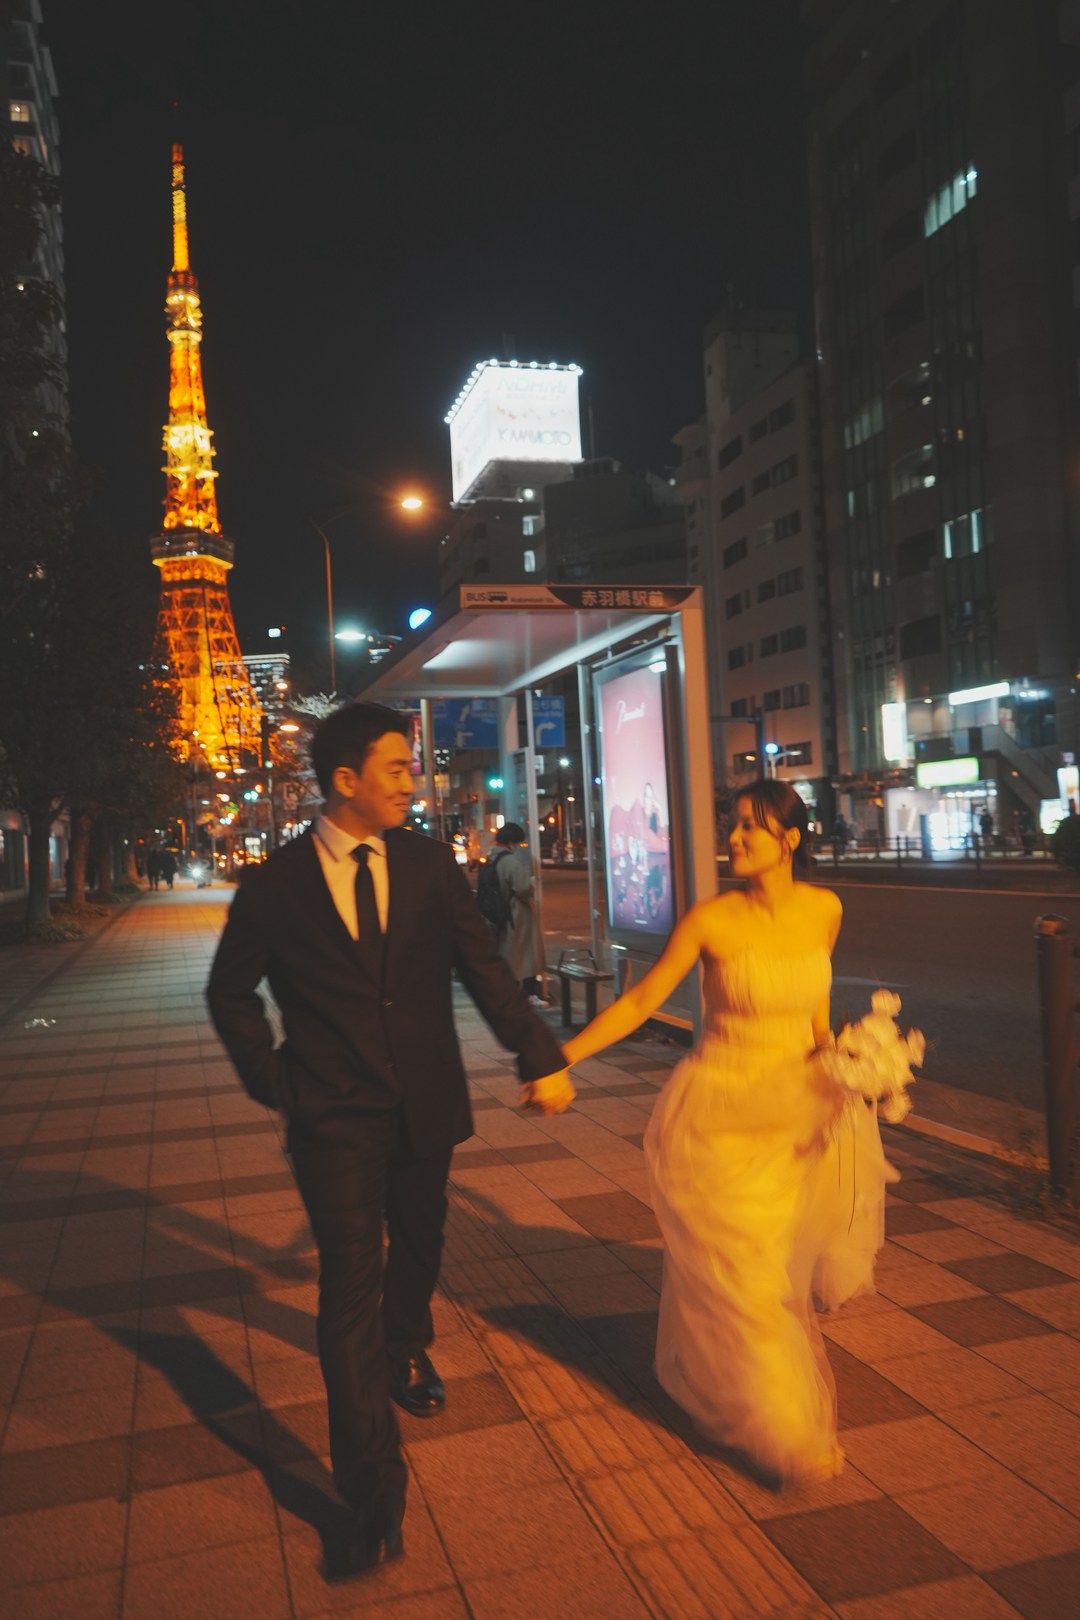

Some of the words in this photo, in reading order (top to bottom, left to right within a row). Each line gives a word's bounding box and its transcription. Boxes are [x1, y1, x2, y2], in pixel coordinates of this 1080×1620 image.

[466, 592, 486, 601] BUS
[581, 590, 664, 606] 赤羽橋駅前
